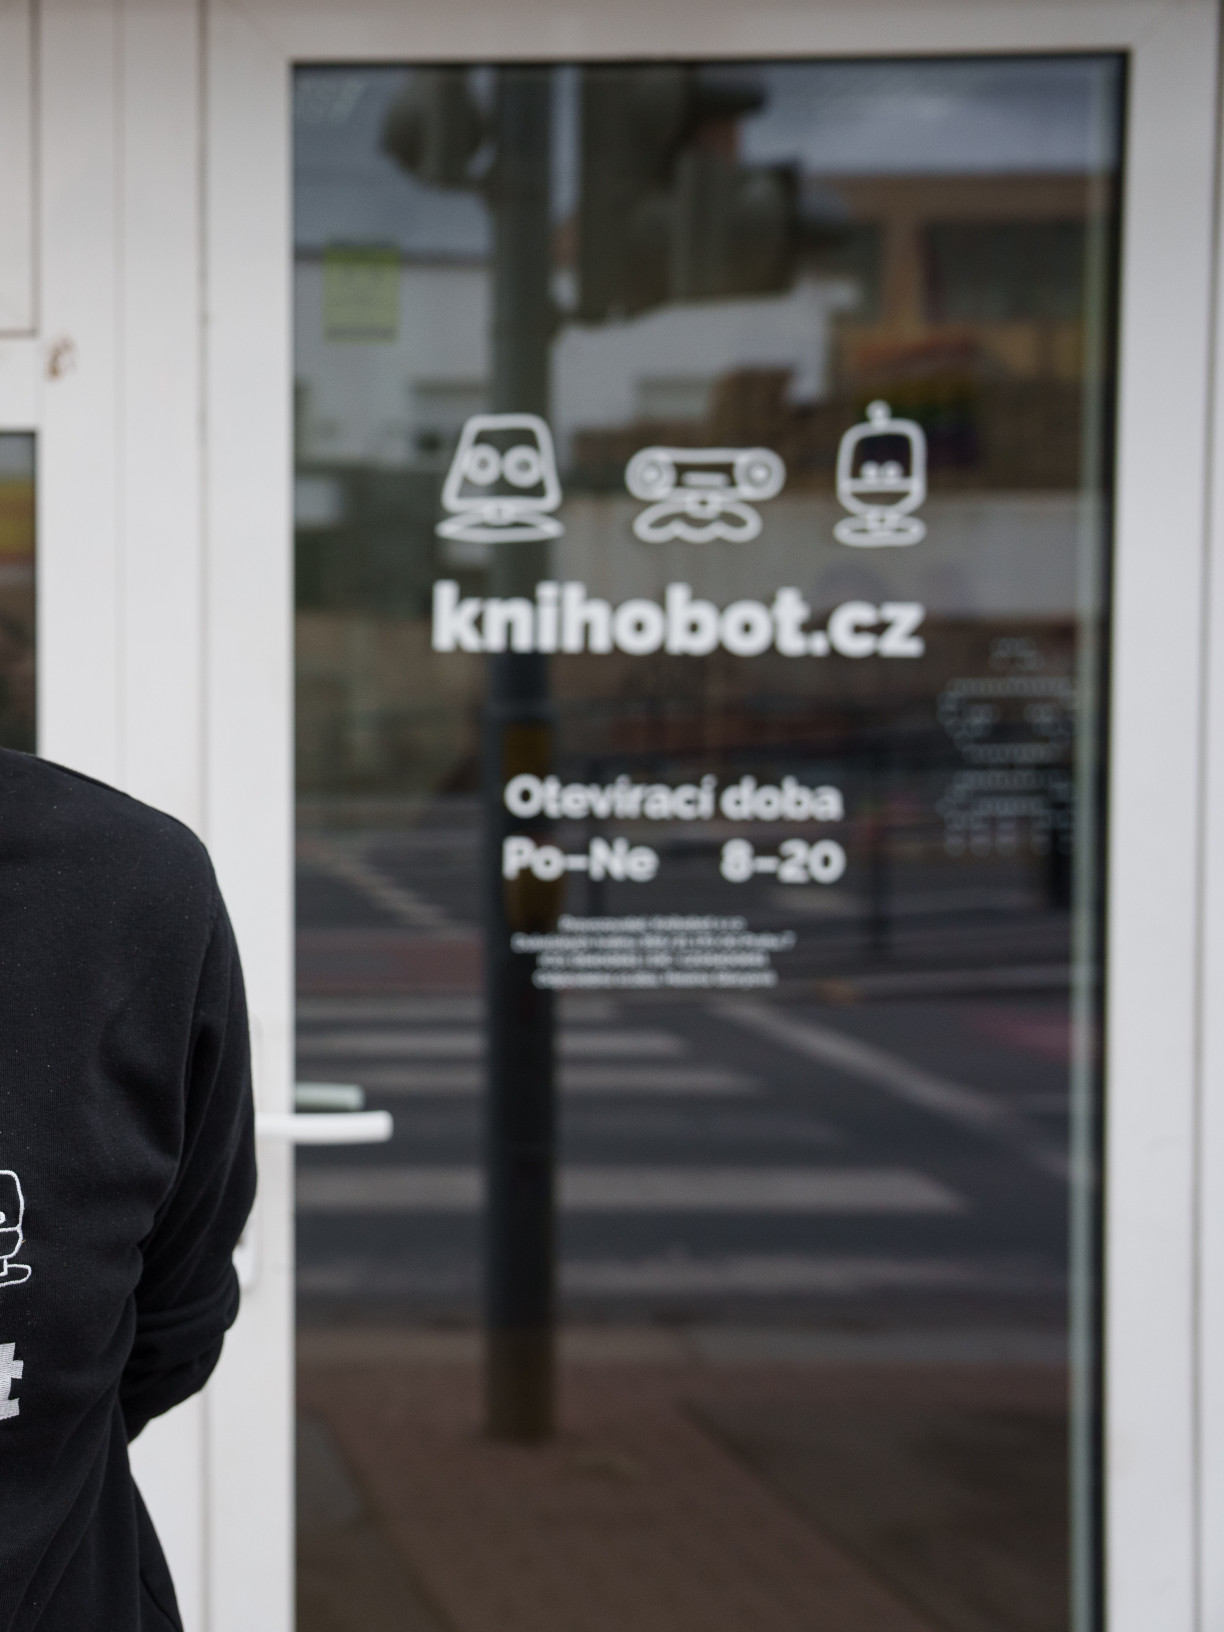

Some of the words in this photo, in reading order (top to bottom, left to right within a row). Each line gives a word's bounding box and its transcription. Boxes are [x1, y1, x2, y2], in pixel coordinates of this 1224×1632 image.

[432, 579, 925, 657] knihobot.cz
[505, 774, 715, 819] Otevírací
[721, 777, 843, 821] doba
